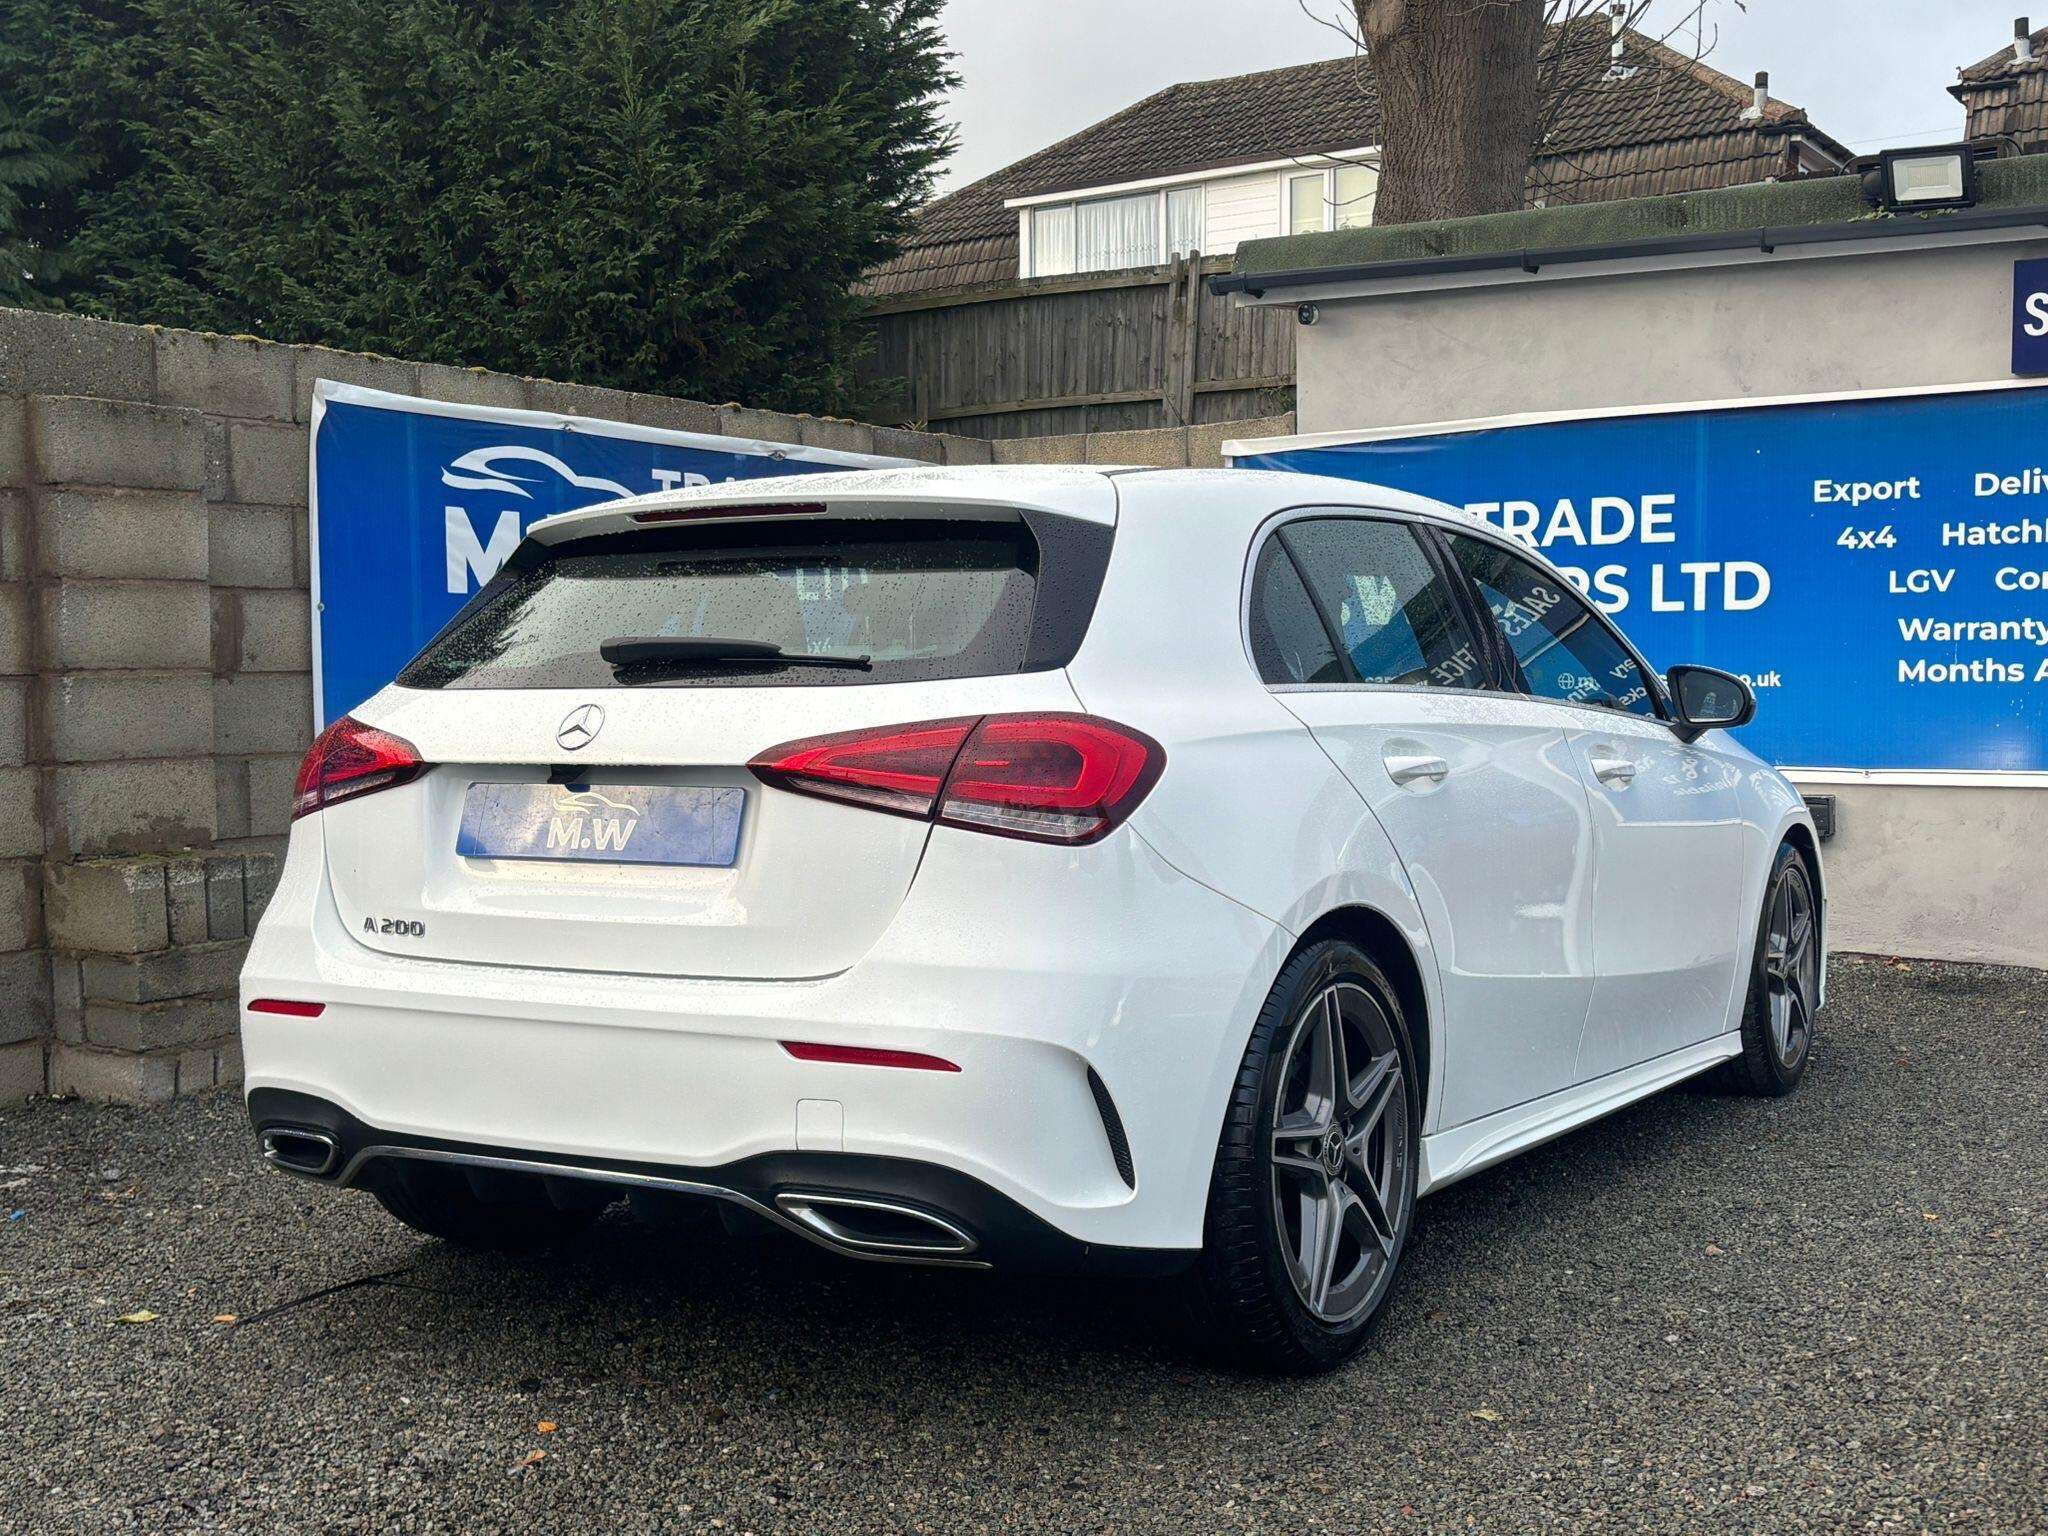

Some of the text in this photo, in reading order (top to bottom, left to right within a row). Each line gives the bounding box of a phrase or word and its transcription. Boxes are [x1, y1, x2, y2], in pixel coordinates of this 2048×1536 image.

[1813, 476, 1921, 507] Export
[1464, 493, 1676, 548] TRADE
[1836, 525, 1897, 550] 4x4
[1651, 560, 1771, 613] LTD
[1889, 568, 1956, 594] LGV
[1897, 616, 2048, 647] Warranty
[1898, 658, 2025, 683] Months
[546, 817, 637, 851] M.W
[364, 916, 426, 938] A 200
